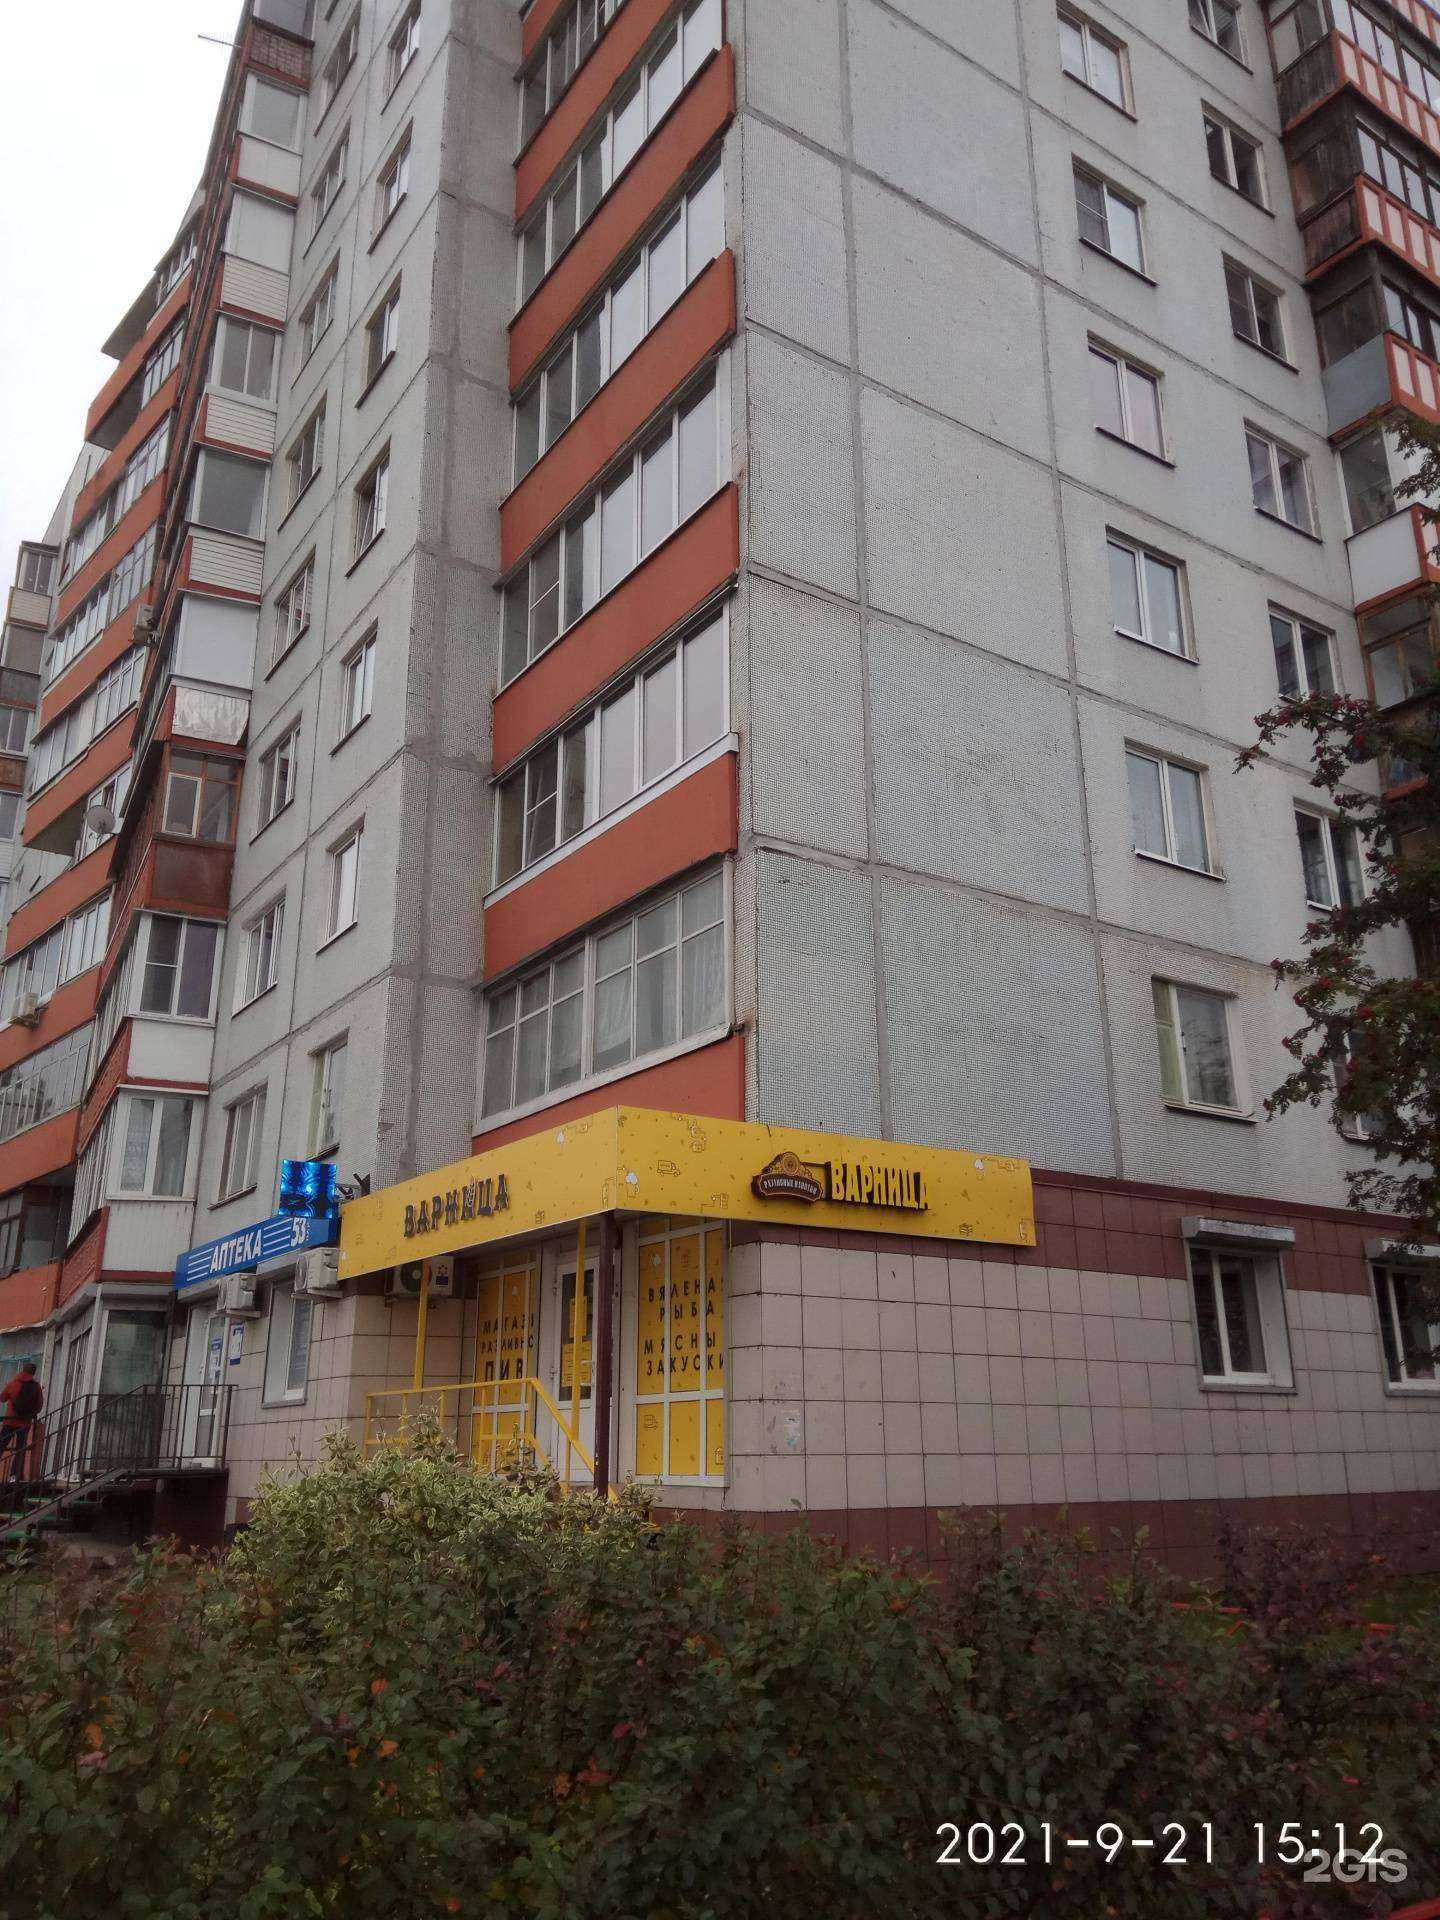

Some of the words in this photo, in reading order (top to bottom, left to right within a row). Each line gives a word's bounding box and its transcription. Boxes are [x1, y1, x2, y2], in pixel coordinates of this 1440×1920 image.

[829, 1155, 929, 1210] ВАРНИЦА
[404, 1174, 508, 1237] ВАРНИЦА
[210, 1229, 262, 1273] АПТЕКА
[648, 1278, 724, 1302] ВЯЛЕНА
[660, 1301, 714, 1322] РЫБА
